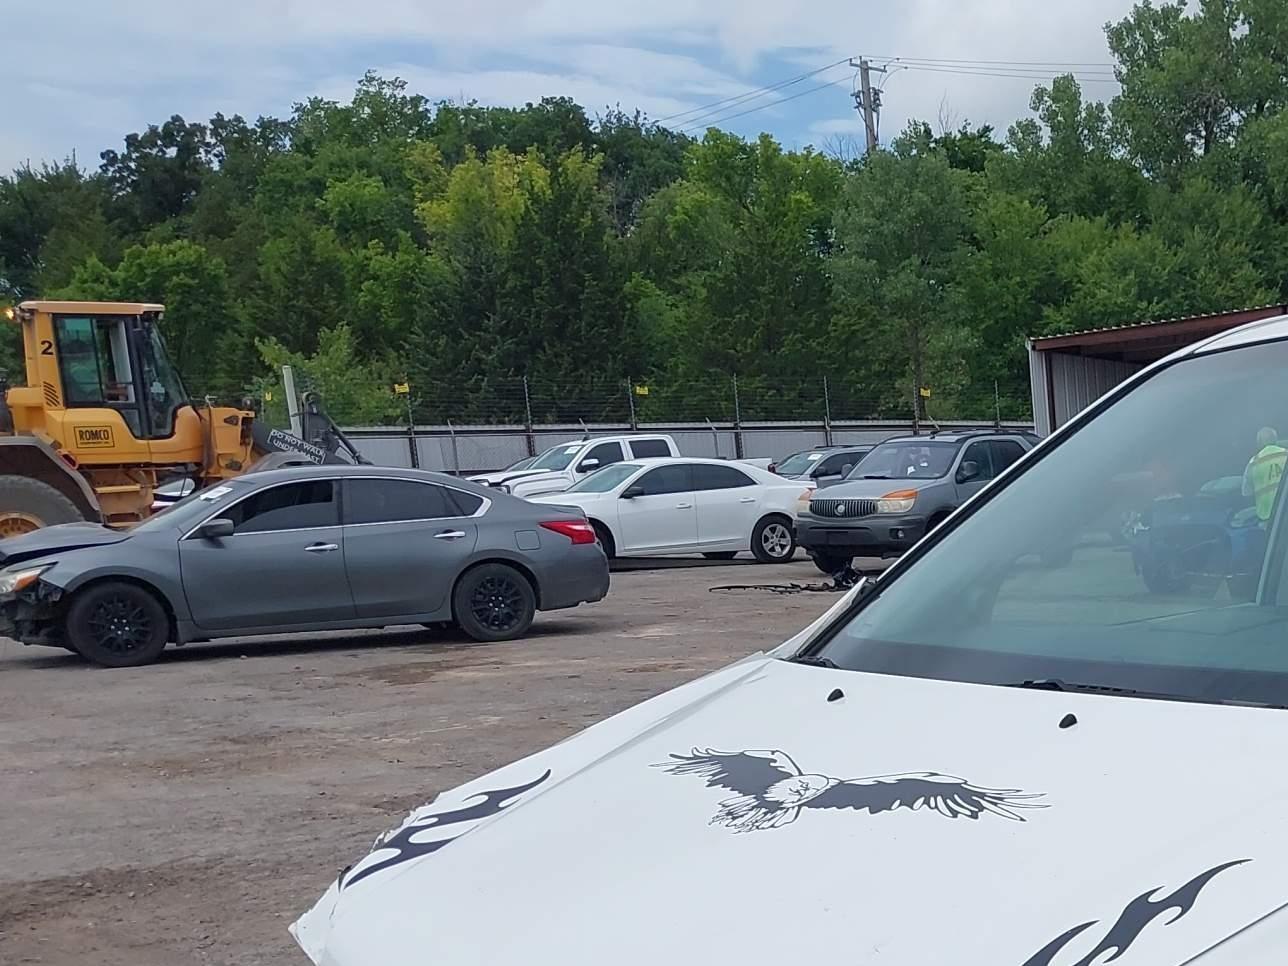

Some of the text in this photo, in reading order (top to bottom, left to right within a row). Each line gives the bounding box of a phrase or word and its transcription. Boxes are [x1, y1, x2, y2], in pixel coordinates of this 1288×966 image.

[40, 340, 54, 355] 2
[79, 429, 110, 441] ROMCO
[271, 430, 325, 457] DO NOT WALK
